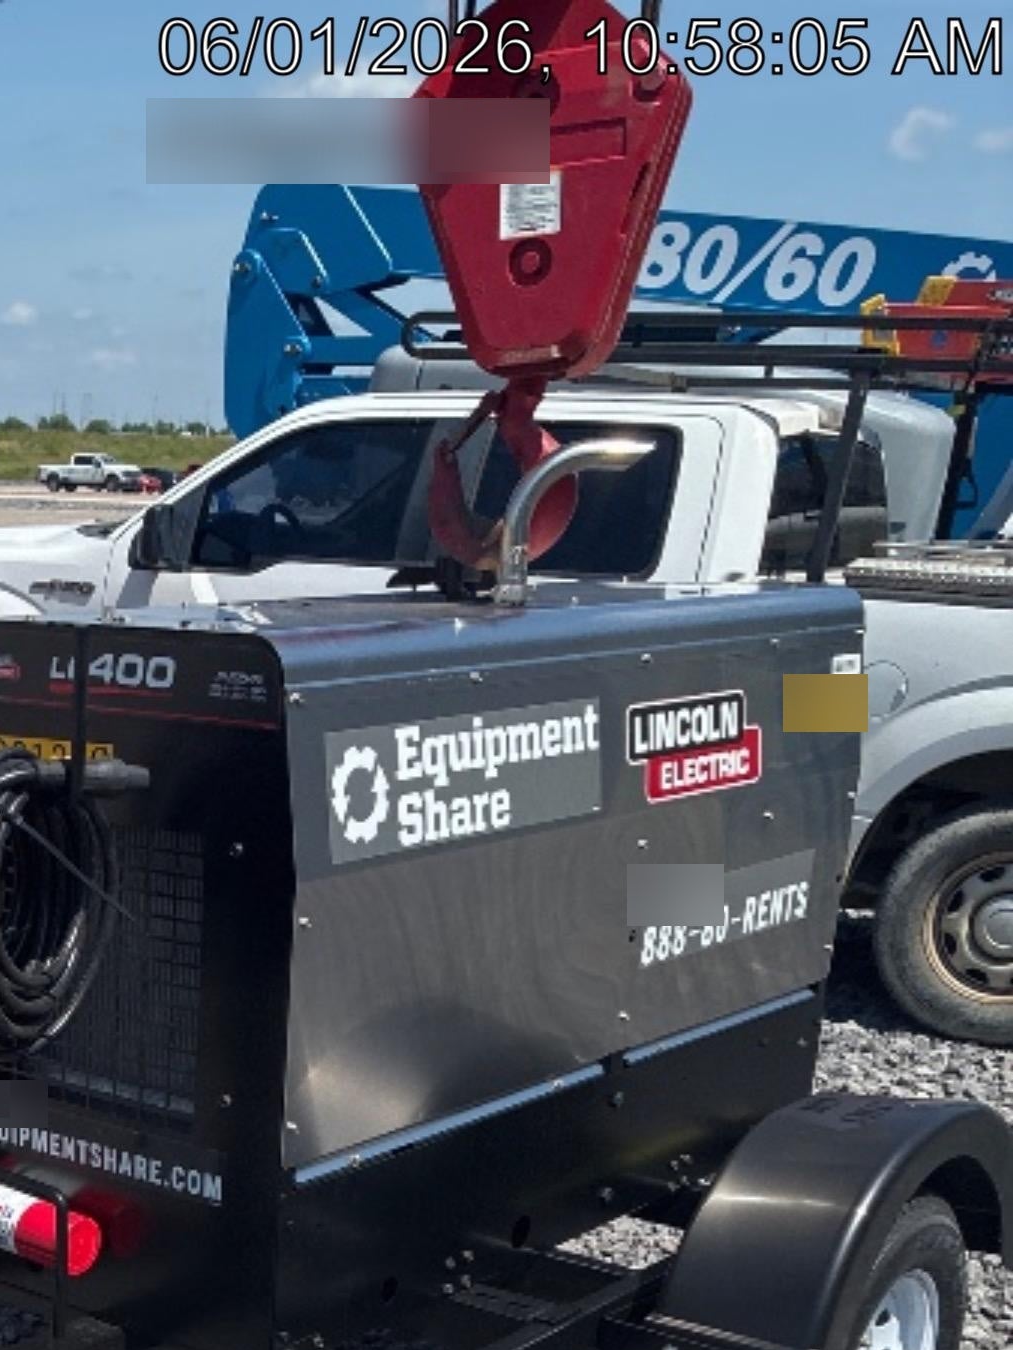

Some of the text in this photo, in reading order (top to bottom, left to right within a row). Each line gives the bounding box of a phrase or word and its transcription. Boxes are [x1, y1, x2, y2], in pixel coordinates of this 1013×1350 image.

[394, 703, 600, 787] Equipment
[634, 701, 739, 754] LINCOLN
[660, 747, 751, 790] ELECTRIC
[397, 788, 511, 846] Share
